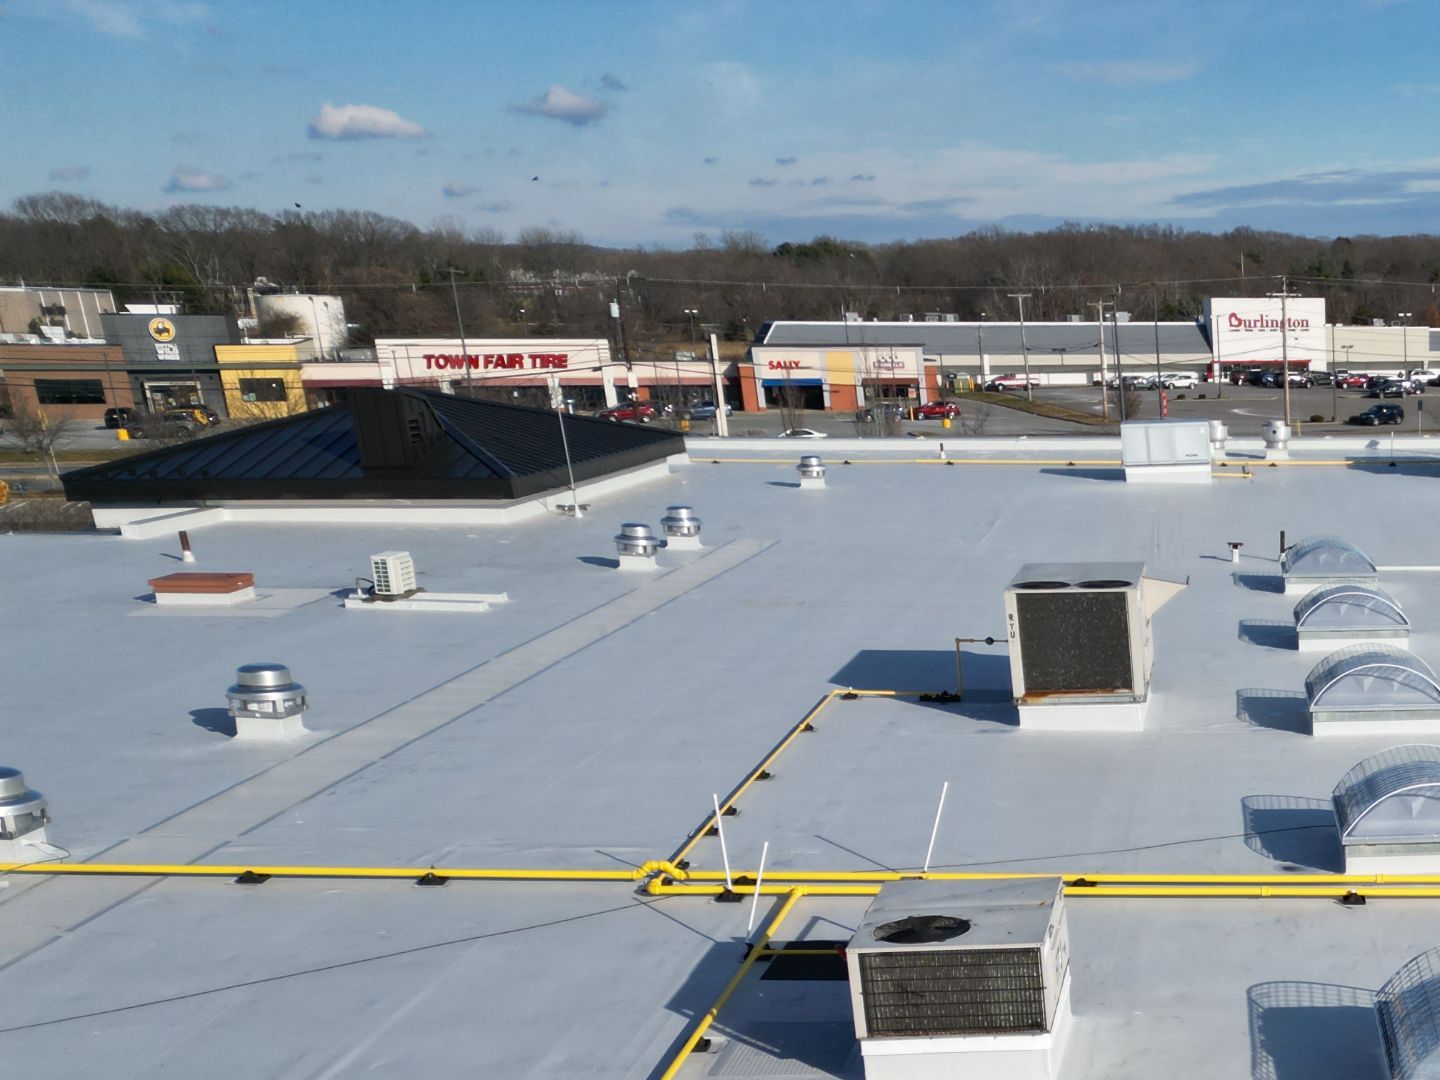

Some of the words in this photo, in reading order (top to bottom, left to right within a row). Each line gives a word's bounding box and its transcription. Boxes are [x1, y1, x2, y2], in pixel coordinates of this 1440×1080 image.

[1228, 312, 1310, 332] Burlington
[423, 354, 480, 369] TOWN
[483, 354, 525, 369] FAIR
[528, 354, 568, 369] TIRE
[768, 360, 801, 370] SALLY
[1008, 613, 1016, 639] RTU
